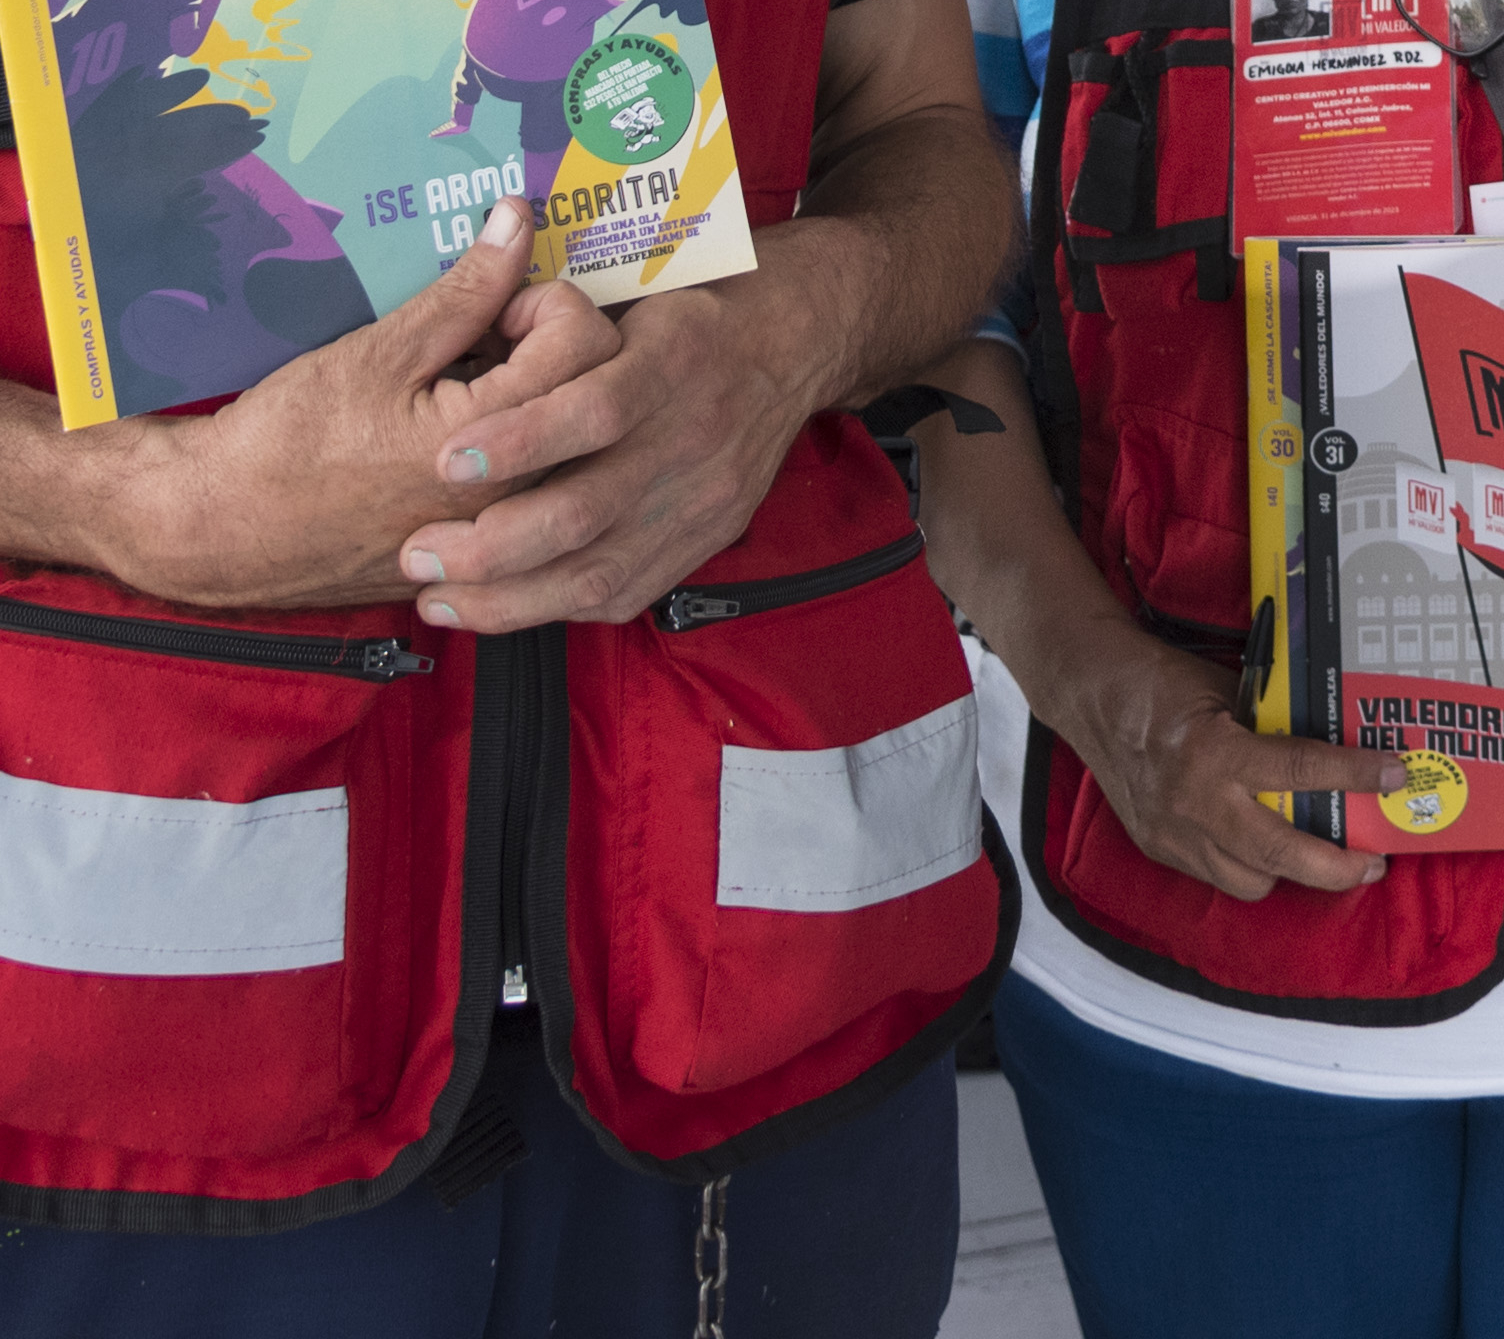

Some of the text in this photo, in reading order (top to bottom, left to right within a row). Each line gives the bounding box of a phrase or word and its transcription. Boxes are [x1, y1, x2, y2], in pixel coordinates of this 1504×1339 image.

[65, 23, 127, 96] 10
[1312, 53, 1387, 71] HERNANDEZ
[568, 39, 682, 124] COMPRAS AYUDAS
[1255, 83, 1419, 104] CENTRO CREATIVO REINSERCIÓN
[1312, 98, 1353, 109] VALEDOR
[364, 153, 525, 228] ¡SE ARMÓ
[432, 168, 681, 254] LA SCARITA!
[565, 211, 662, 243] ¿PUEDE UNA OLA
[565, 212, 712, 254] DERRUMBAR ESTADIO?
[567, 231, 684, 265] PROYECTO TSUNAMI
[569, 244, 676, 277] PAMELA ZEFERINO
[1263, 260, 1274, 330] CASCARITA!
[65, 235, 105, 400] COMPRAS AYUDAS
[1316, 269, 1330, 416] ¡VALEDORES MUNDO!
[1271, 437, 1295, 459] 30
[1325, 445, 1344, 465] 31
[1414, 486, 1438, 516] MV
[1327, 667, 1337, 721] EMPLEAS
[1358, 725, 1410, 753] DEL
[1427, 753, 1463, 785] AYUDAS
